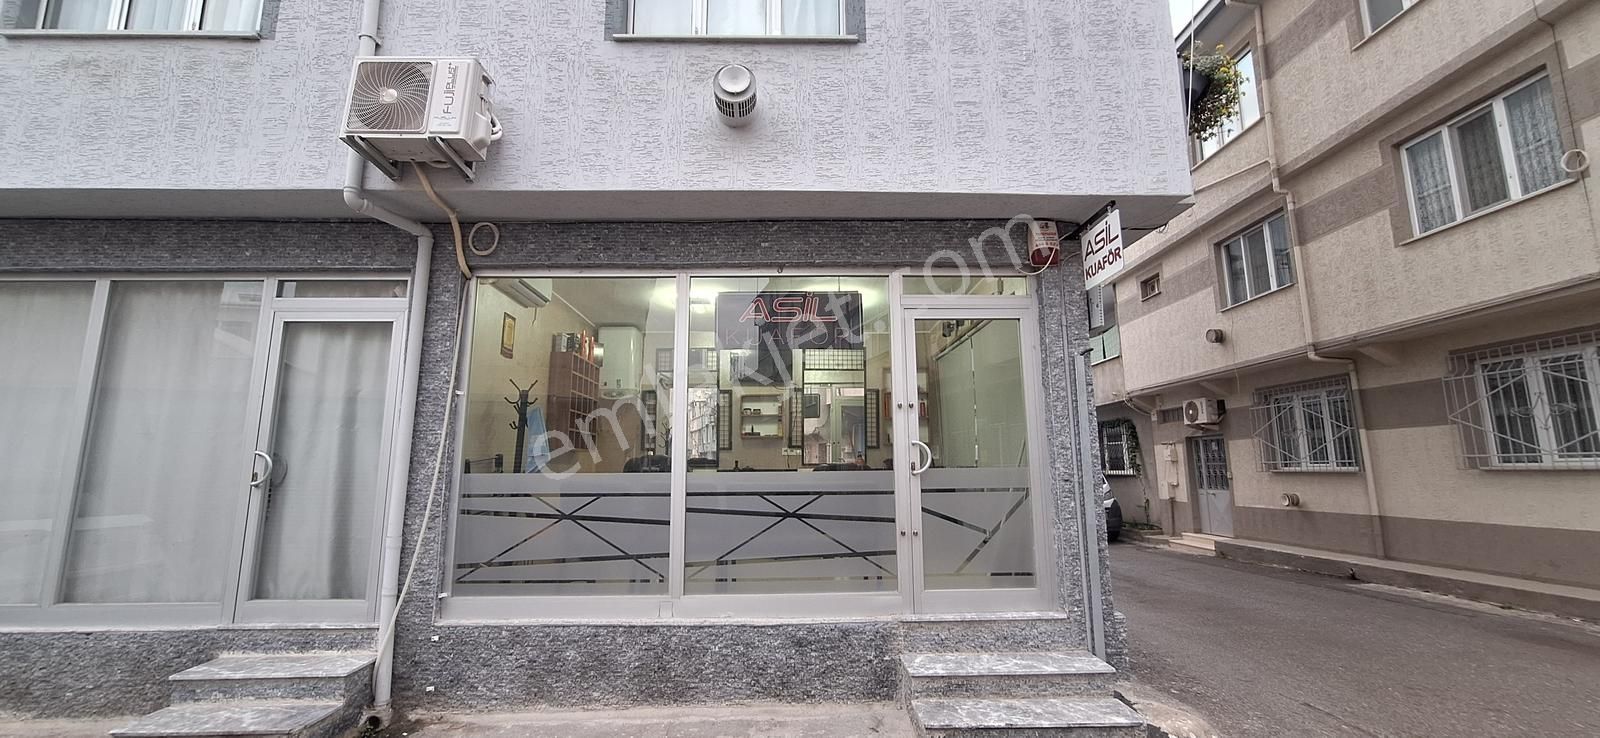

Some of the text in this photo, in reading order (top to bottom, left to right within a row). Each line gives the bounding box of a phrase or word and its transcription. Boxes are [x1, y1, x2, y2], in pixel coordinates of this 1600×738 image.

[1084, 221, 1119, 261] ASİL
[1085, 247, 1122, 280] KUAFÖR
[739, 293, 838, 323] ASİL
